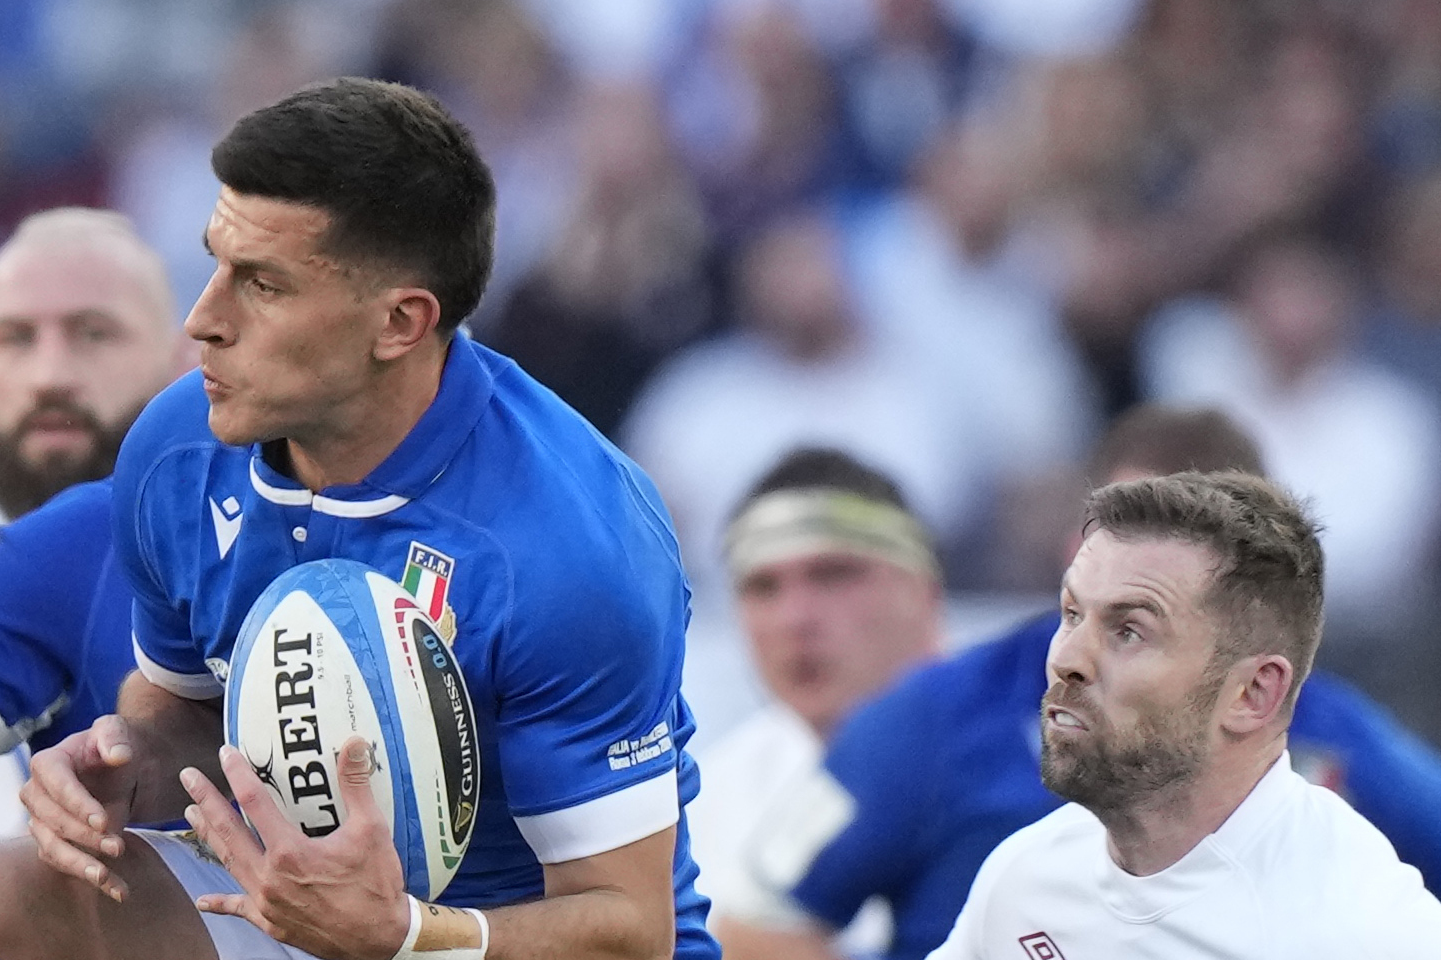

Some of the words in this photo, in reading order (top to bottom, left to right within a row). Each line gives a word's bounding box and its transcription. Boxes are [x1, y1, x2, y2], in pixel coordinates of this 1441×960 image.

[414, 550, 448, 577] F.I.R.
[422, 634, 448, 669] 0.0
[274, 628, 341, 838] LBERT
[442, 672, 474, 797] GUINNESS
